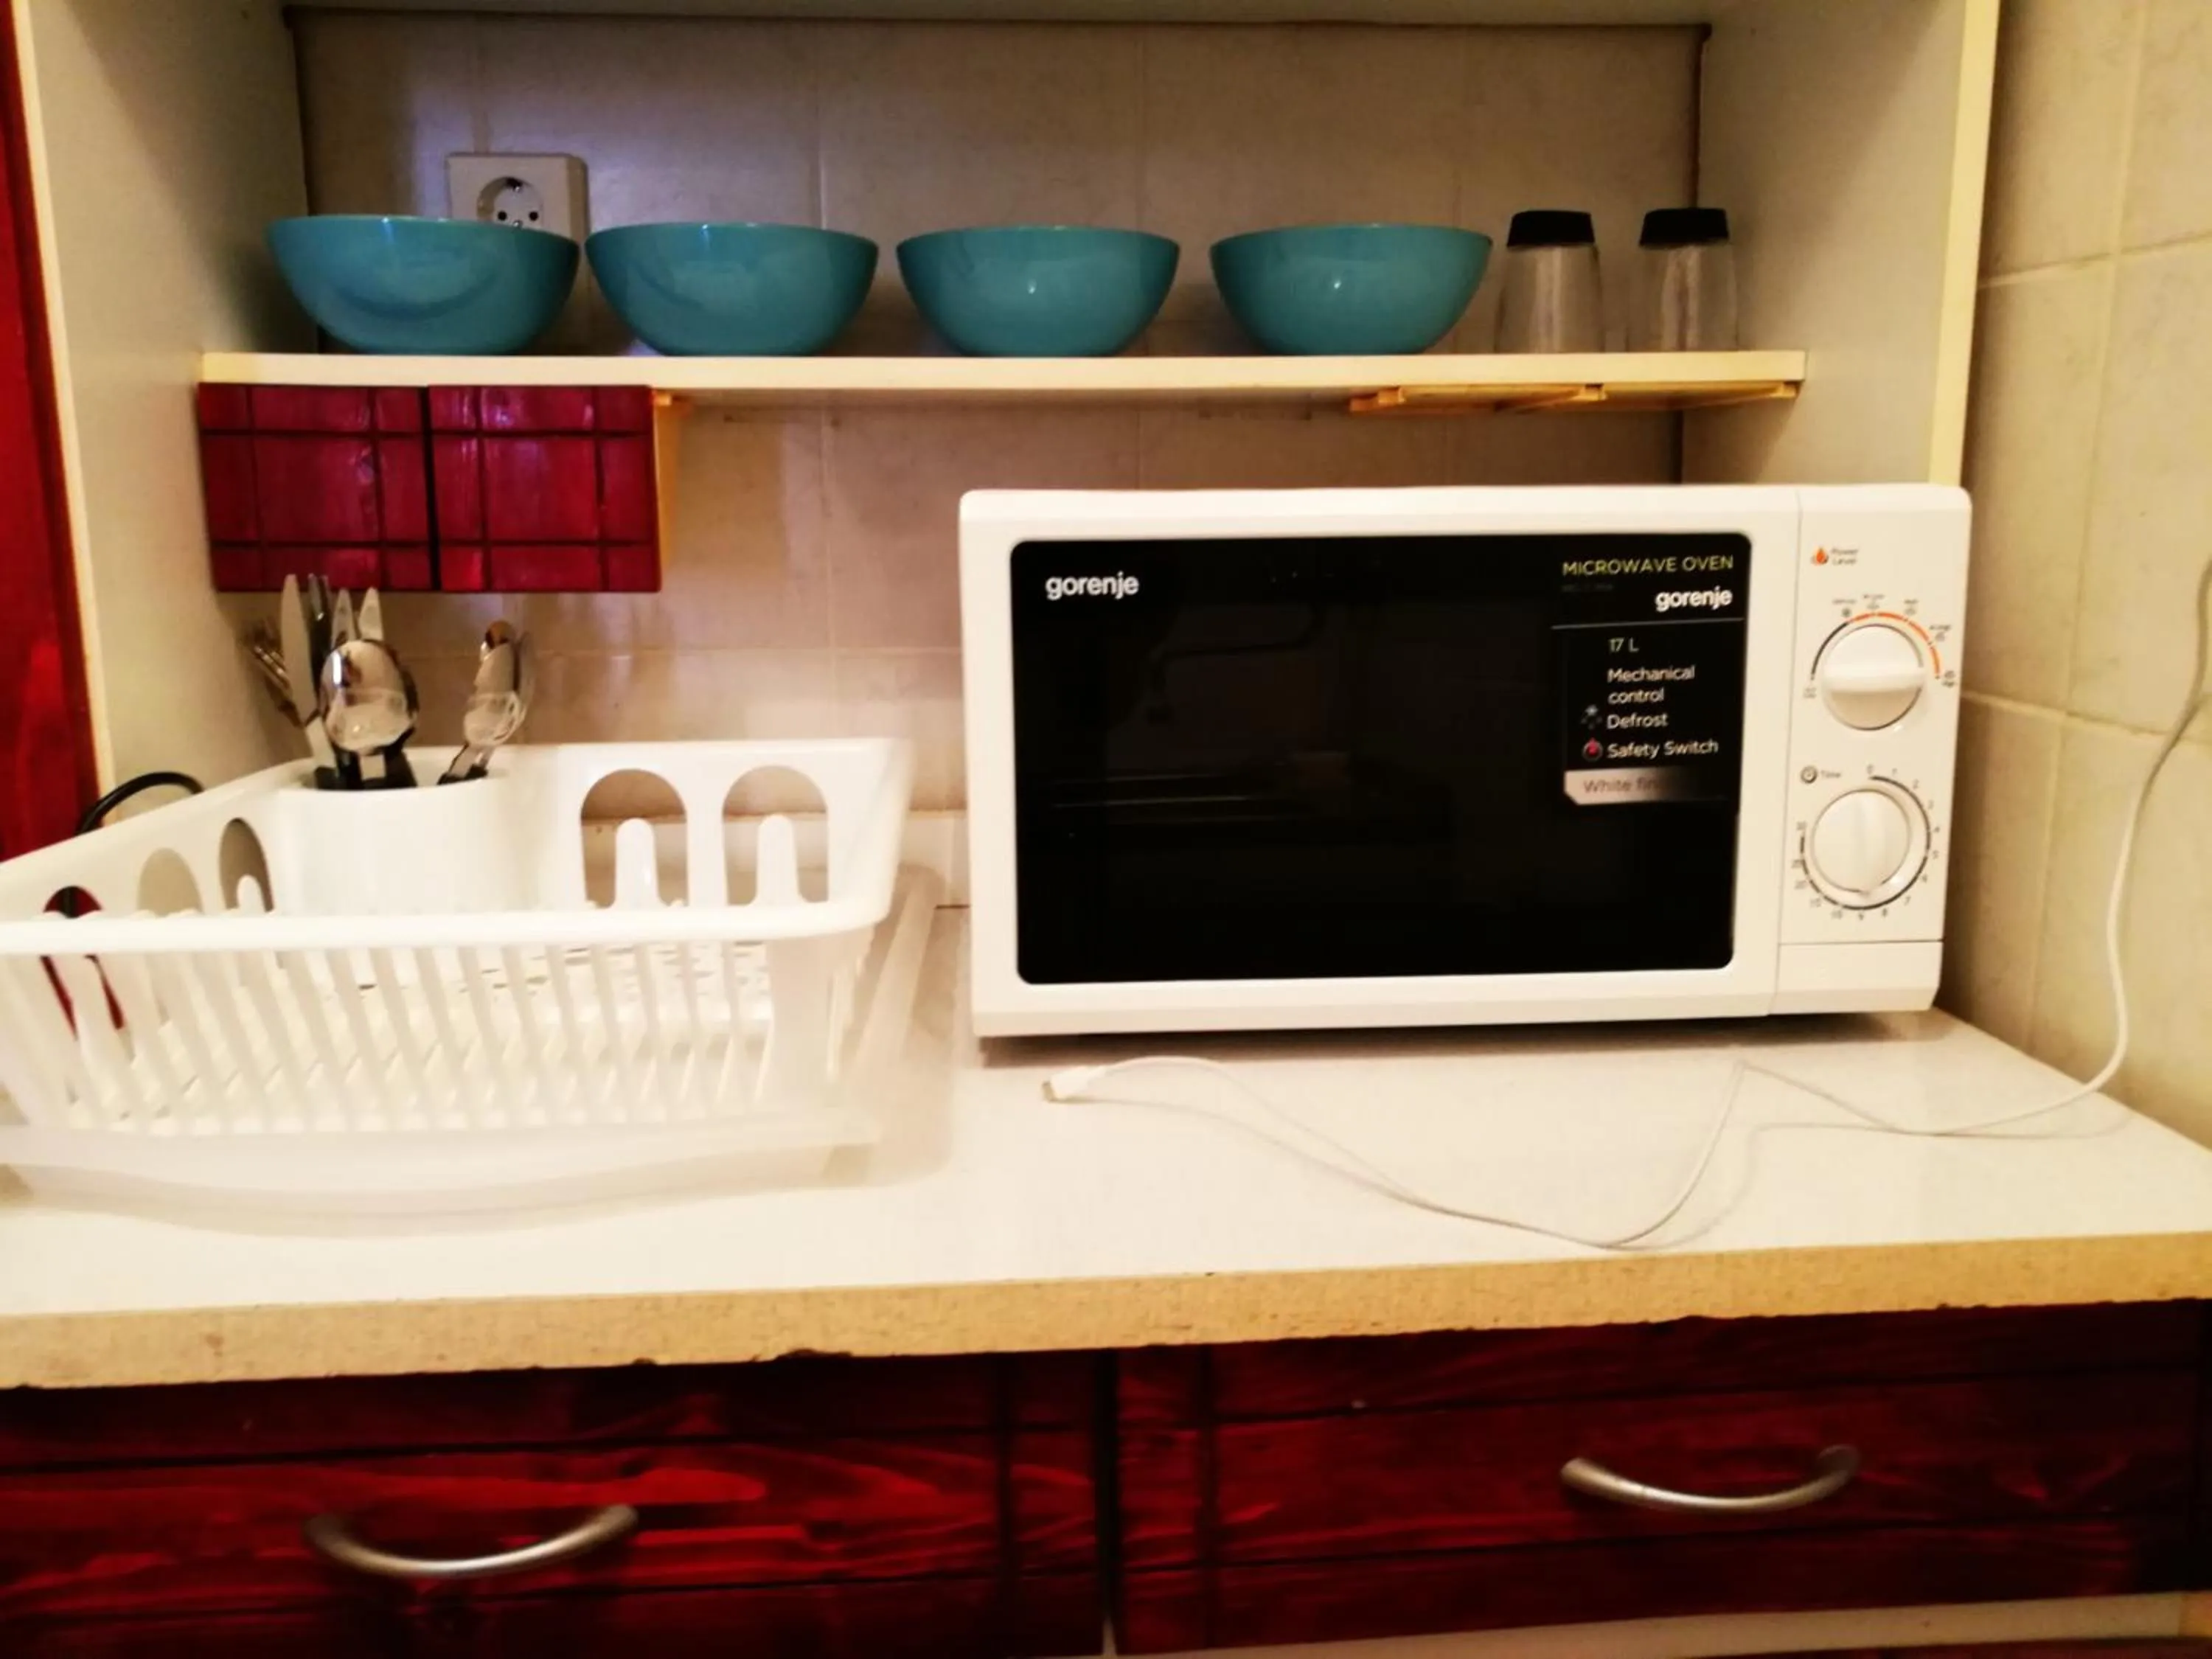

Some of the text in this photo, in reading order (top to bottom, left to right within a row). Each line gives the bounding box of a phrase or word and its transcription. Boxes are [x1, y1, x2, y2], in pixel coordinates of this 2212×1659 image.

[1562, 554, 1733, 576] MICROWAVE OVEN
[1045, 570, 1139, 601] gorenje
[1655, 585, 1733, 613] gorenje
[1609, 637, 1640, 653] 17 L
[1607, 665, 1695, 683] Mechanical
[1608, 687, 1664, 705] control
[1607, 712, 1668, 729] Defrost
[1607, 739, 1719, 759] Safety Switch
[1582, 778, 1632, 793] White
